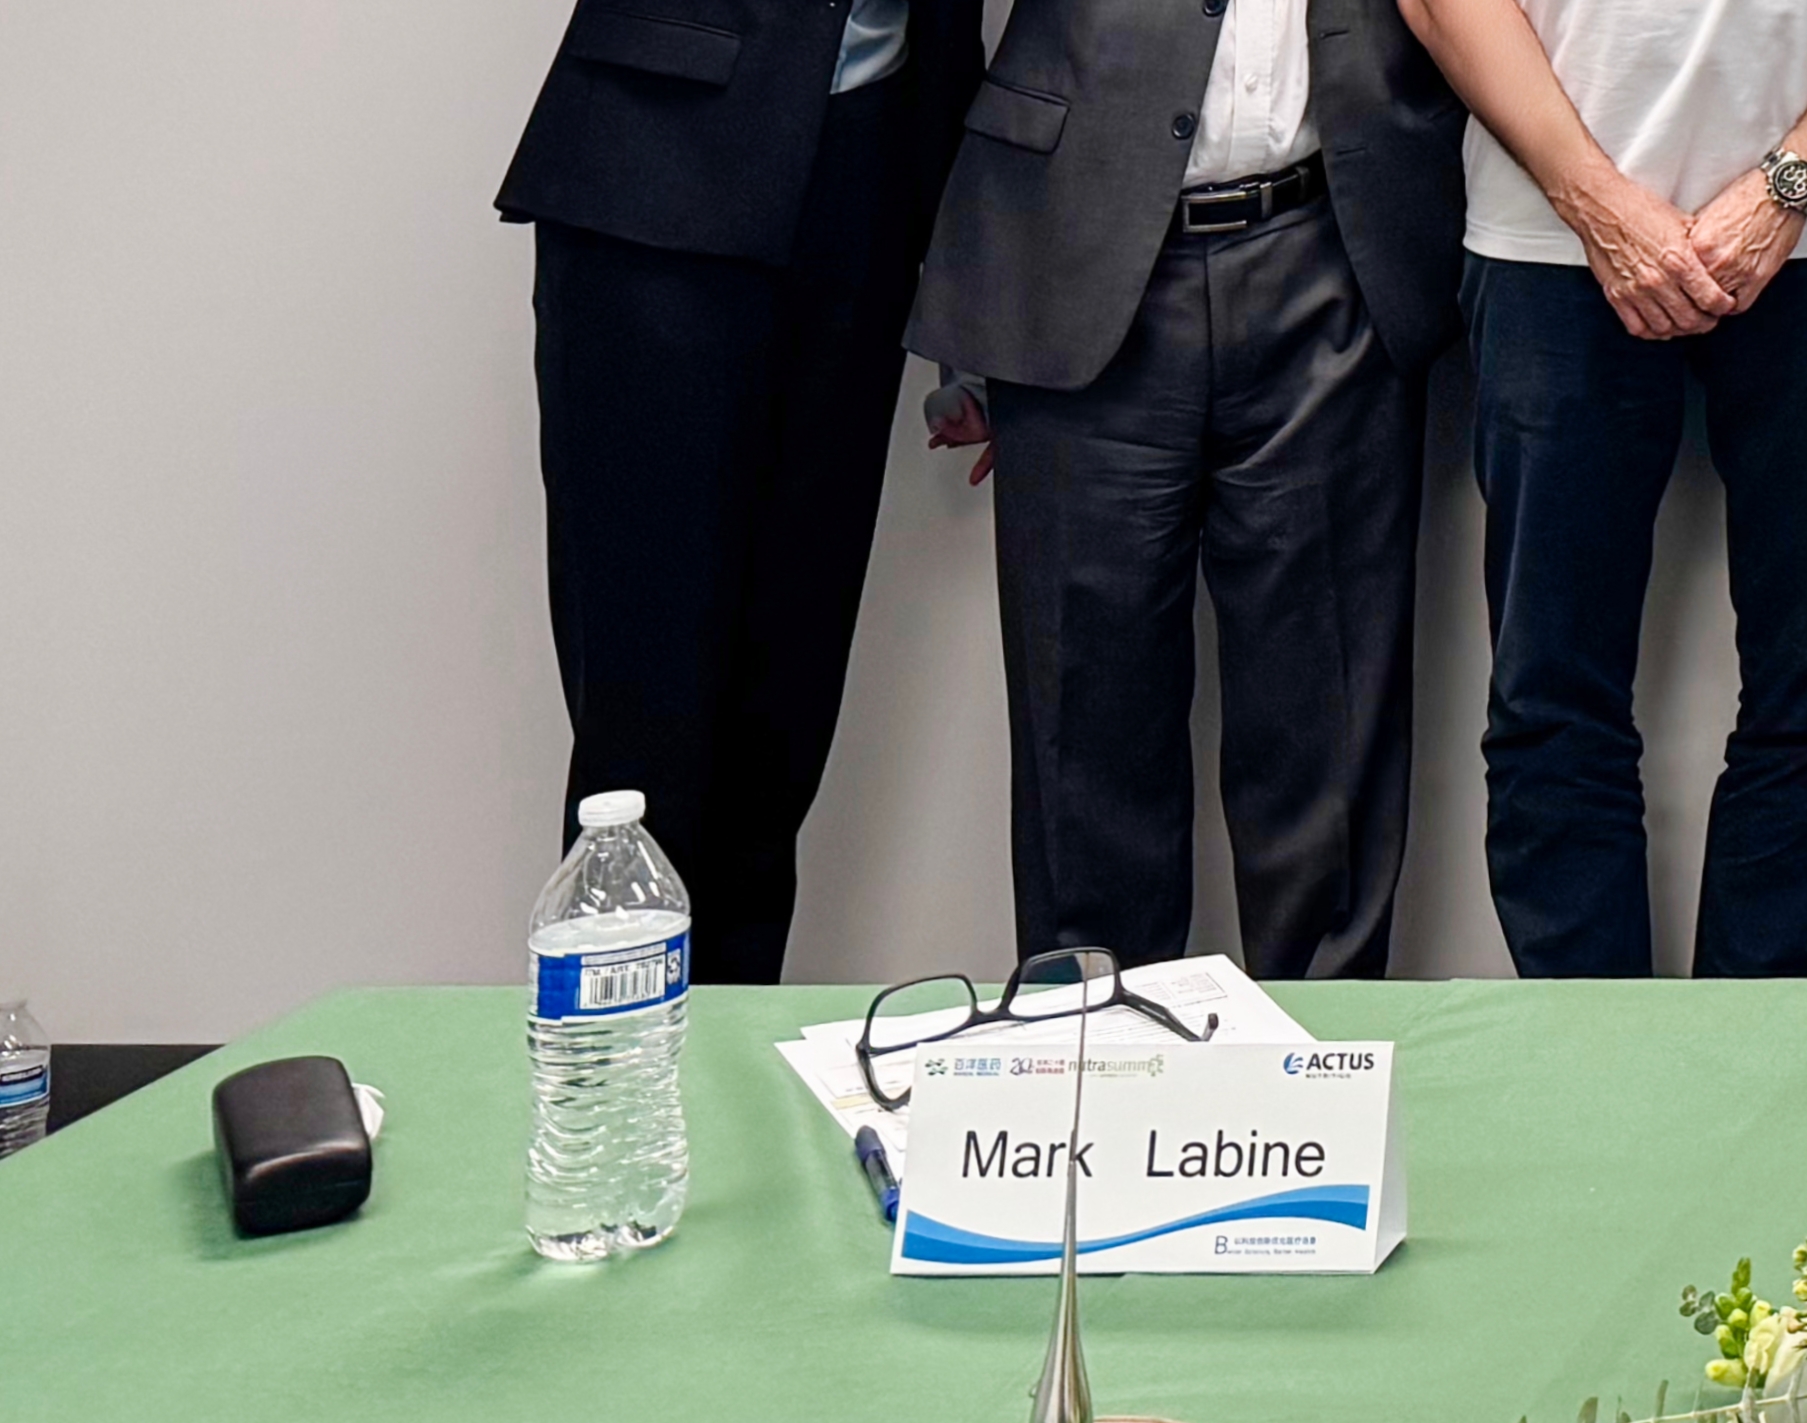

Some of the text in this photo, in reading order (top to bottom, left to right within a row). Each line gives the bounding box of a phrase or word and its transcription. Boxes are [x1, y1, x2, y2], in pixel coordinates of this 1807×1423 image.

[1306, 1053, 1374, 1070] ACTUS
[962, 1129, 1326, 1178] Mark Labine
